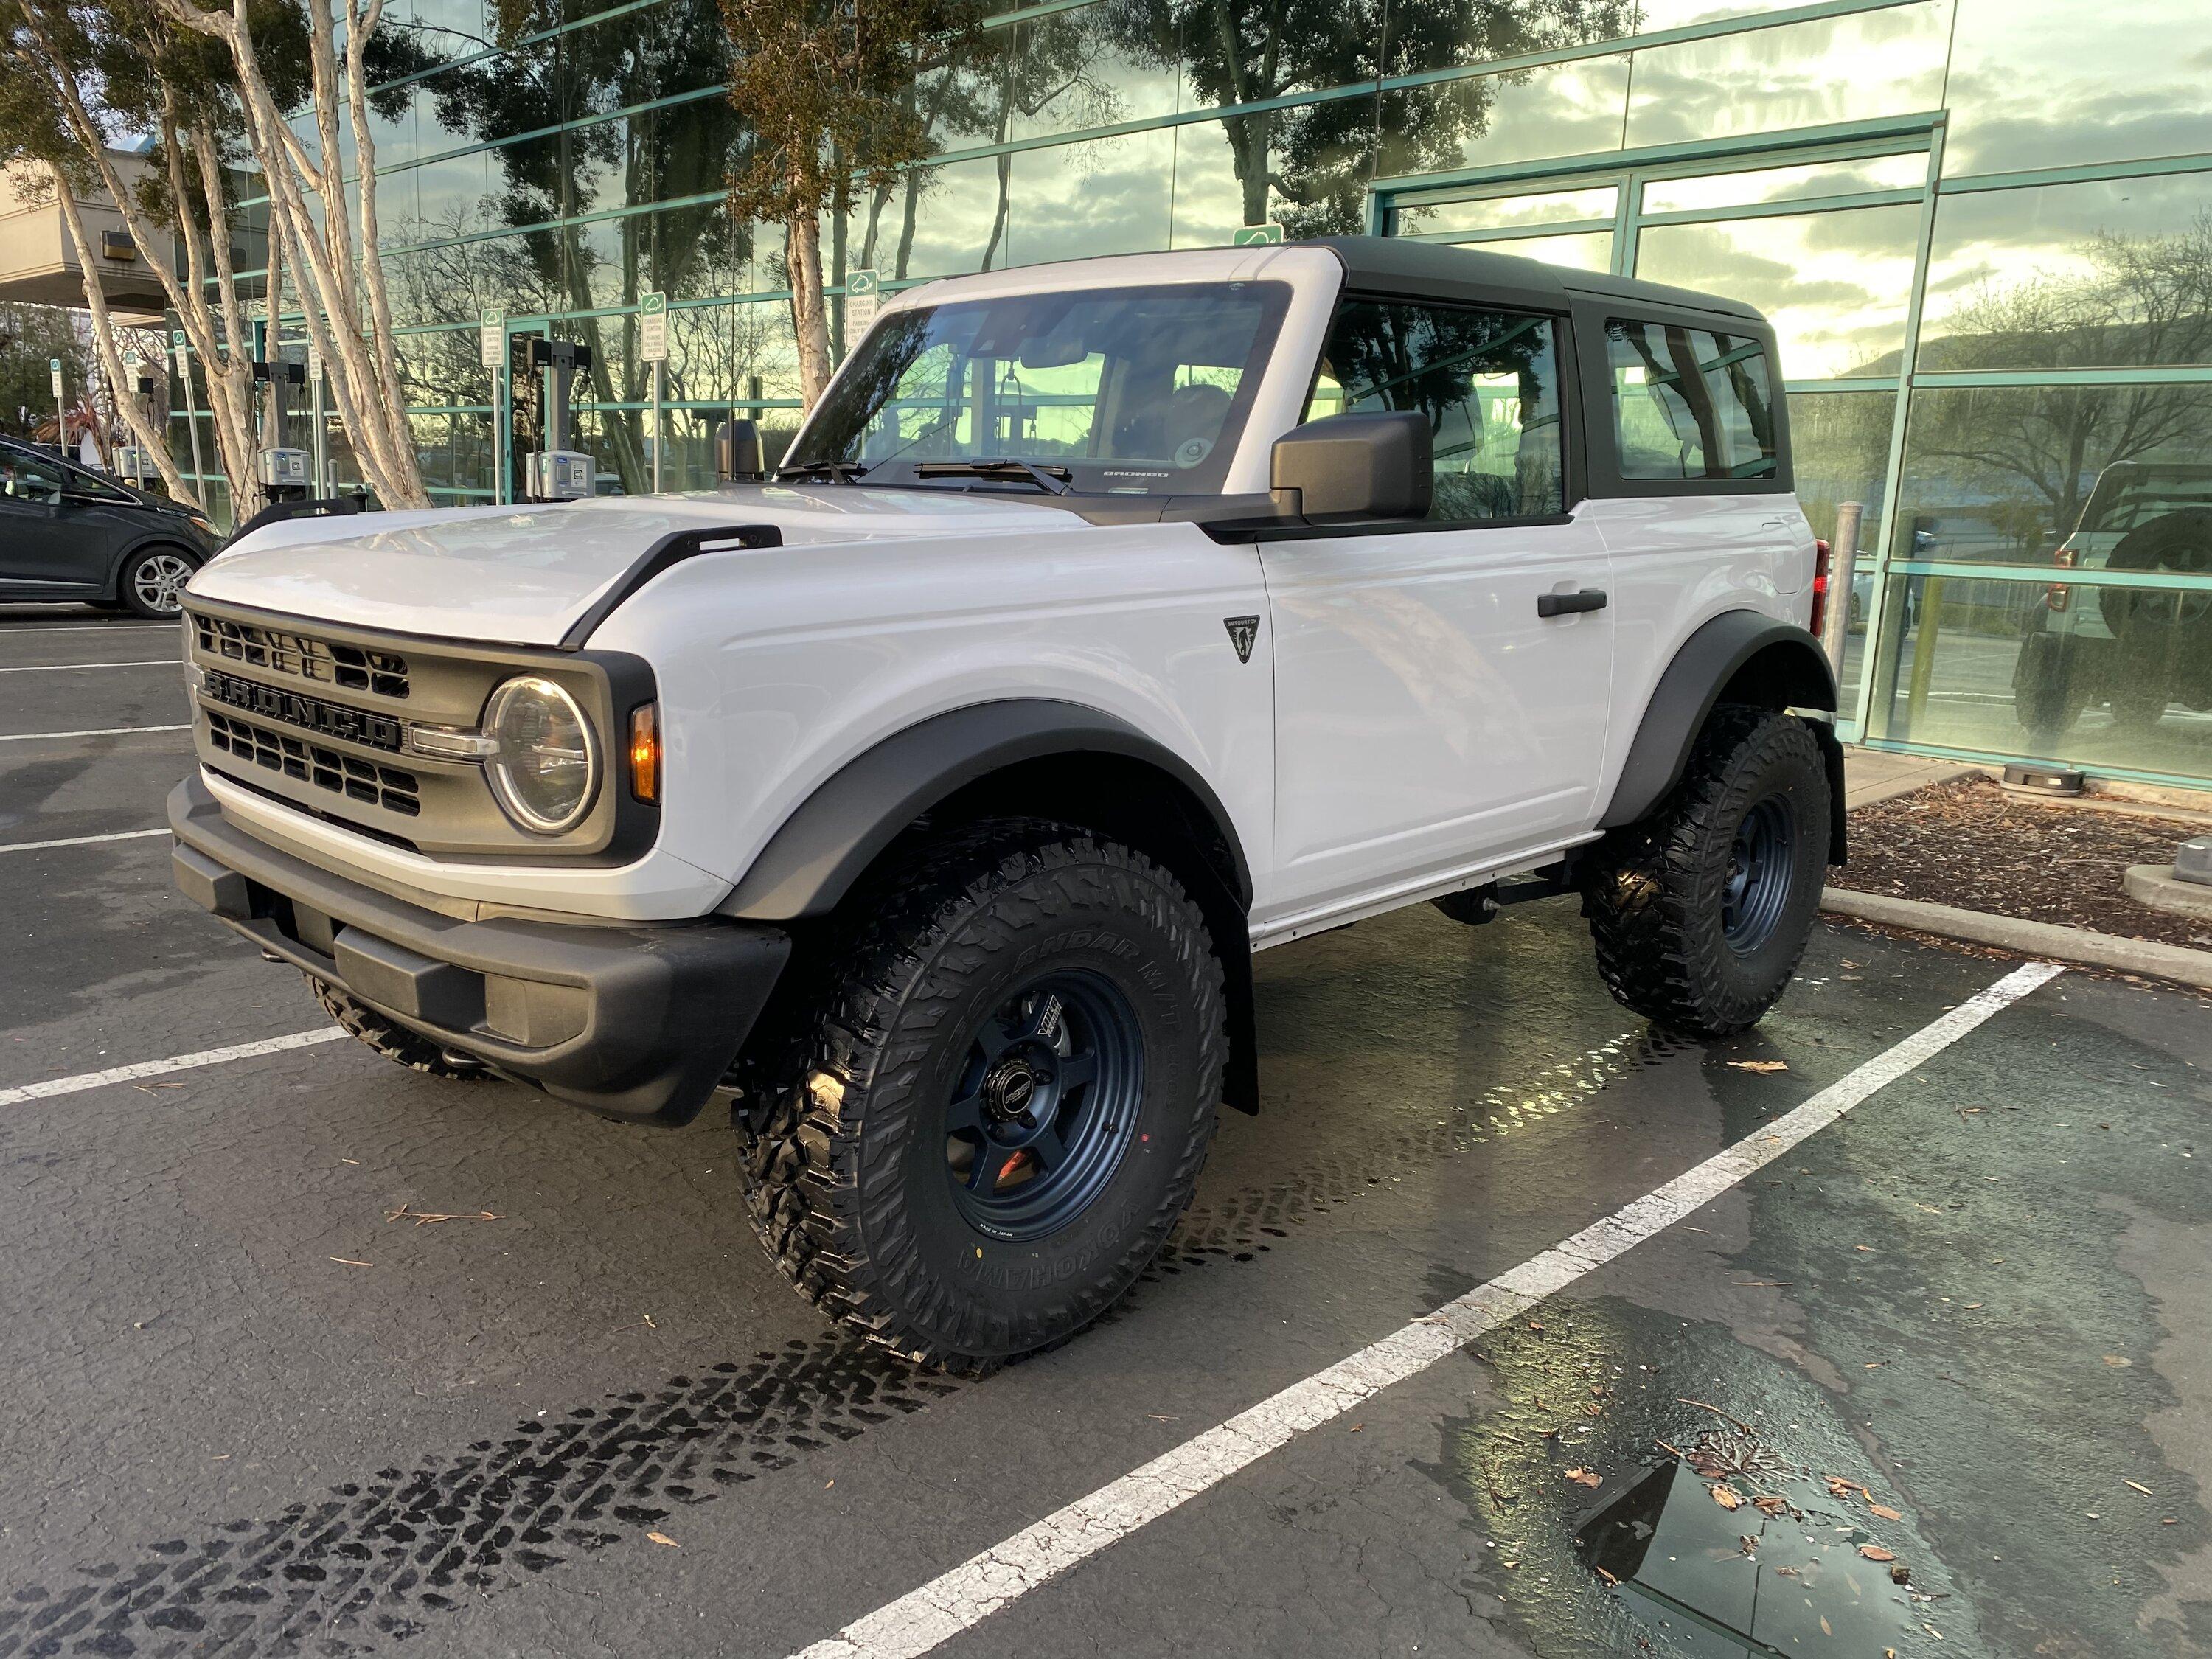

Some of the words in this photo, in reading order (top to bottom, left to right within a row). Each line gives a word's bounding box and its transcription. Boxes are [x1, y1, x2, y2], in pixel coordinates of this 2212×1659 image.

[849, 299, 873, 307] CHARGING
[203, 670, 403, 749] BRONCO
[958, 1199, 1141, 1290] YOKOHAMA
